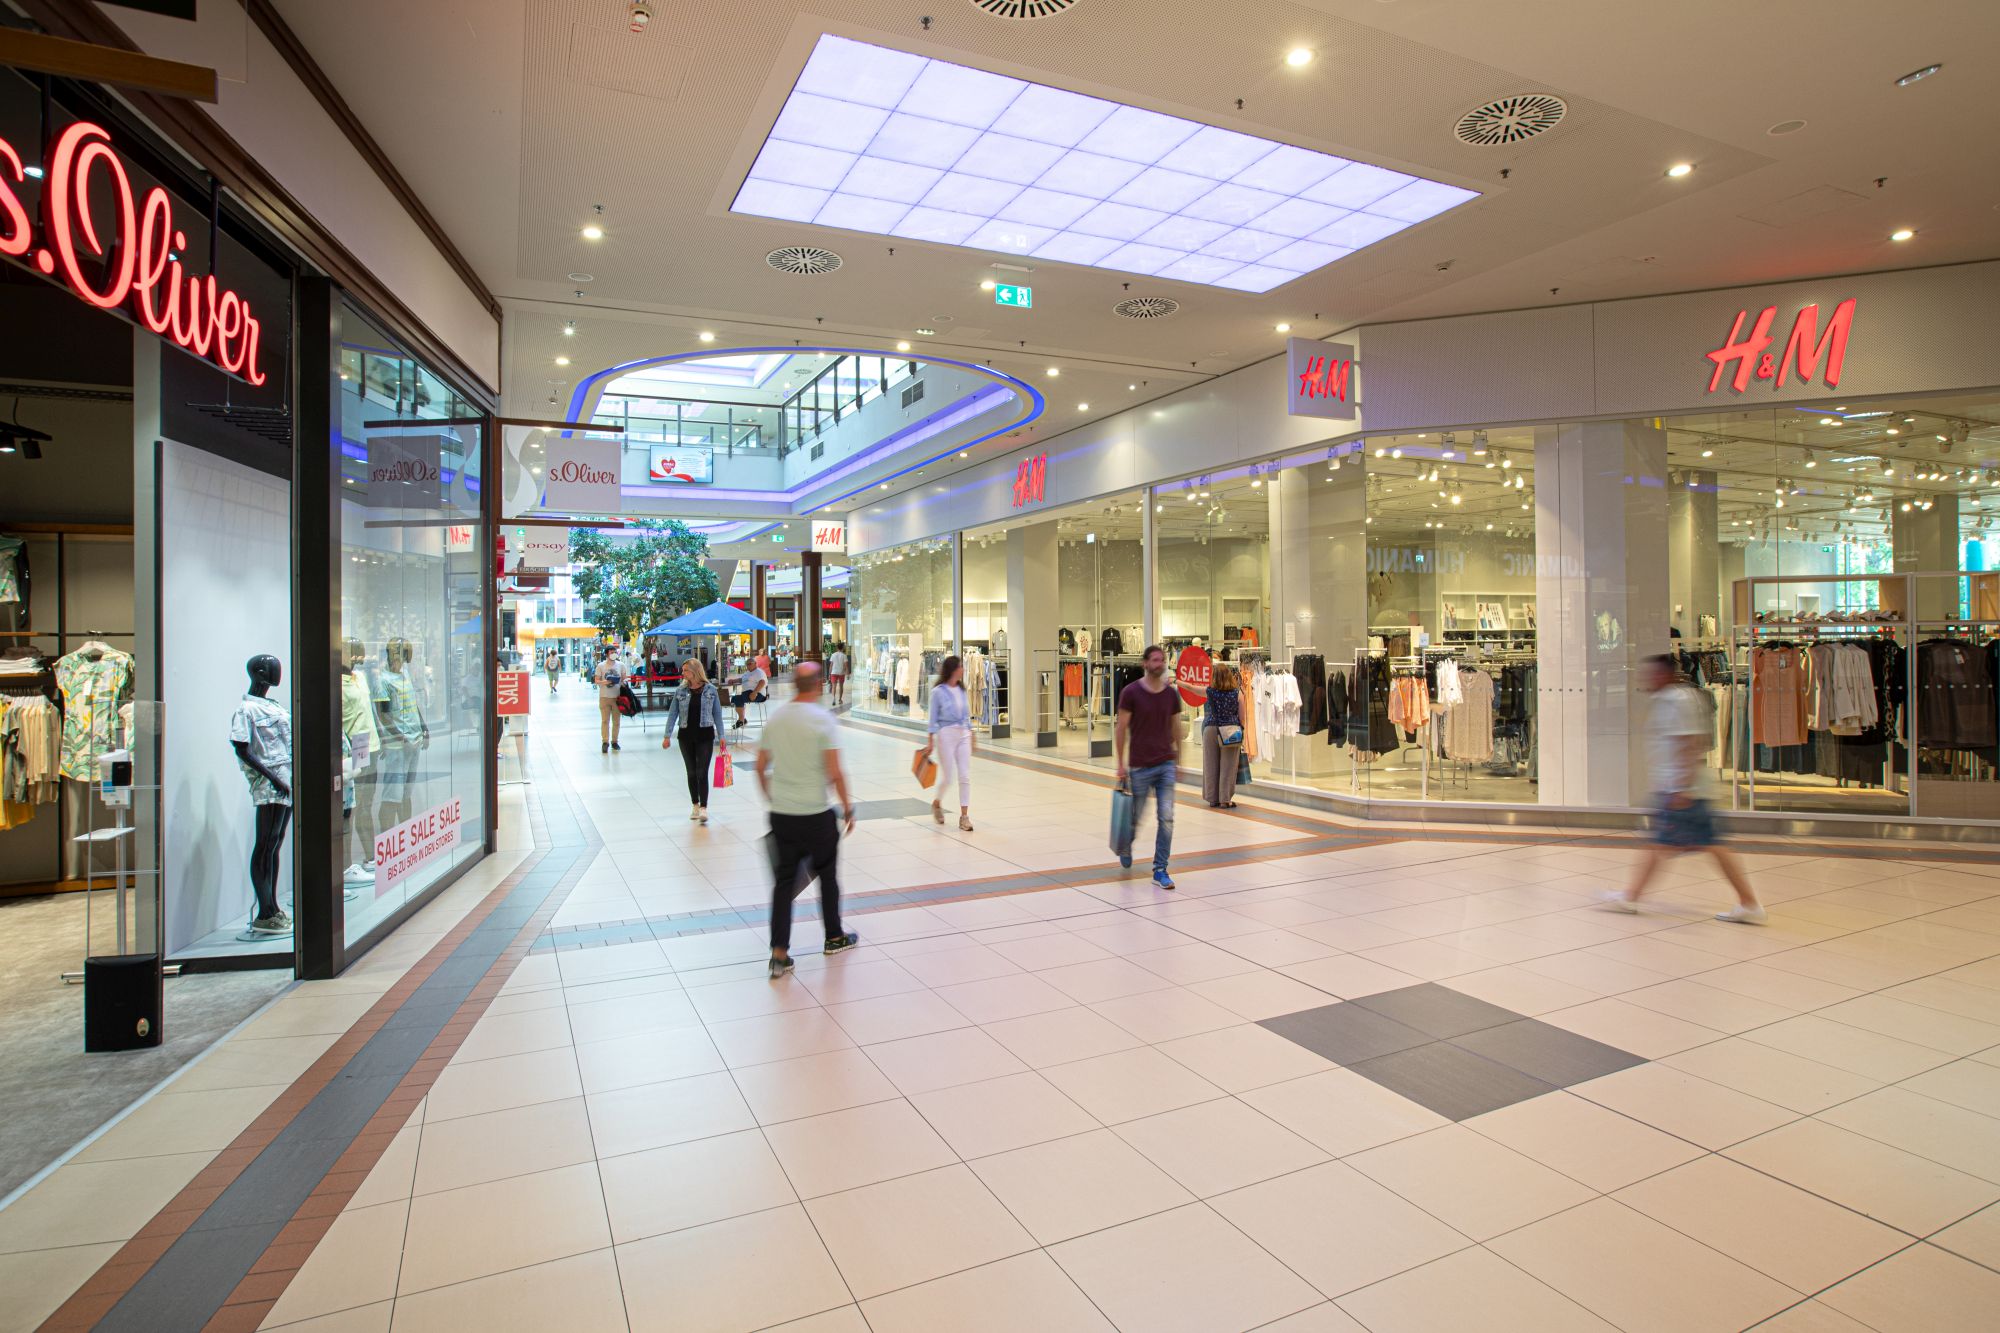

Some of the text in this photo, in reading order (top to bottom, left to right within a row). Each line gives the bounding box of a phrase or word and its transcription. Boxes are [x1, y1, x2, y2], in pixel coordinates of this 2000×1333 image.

[0, 120, 266, 387] s.Oliver
[1704, 297, 1858, 395] H&M
[1298, 355, 1352, 402] H&M
[549, 459, 617, 485] s.Oliver
[1011, 451, 1047, 508] H&M
[526, 542, 566, 553] orsay
[815, 526, 842, 545] H&M
[498, 672, 519, 706] SALE
[1179, 665, 1210, 682] SALE
[377, 802, 460, 866] SALE SALE SALE
[388, 831, 454, 880] BIS ZU 50% IN DEN STORES
